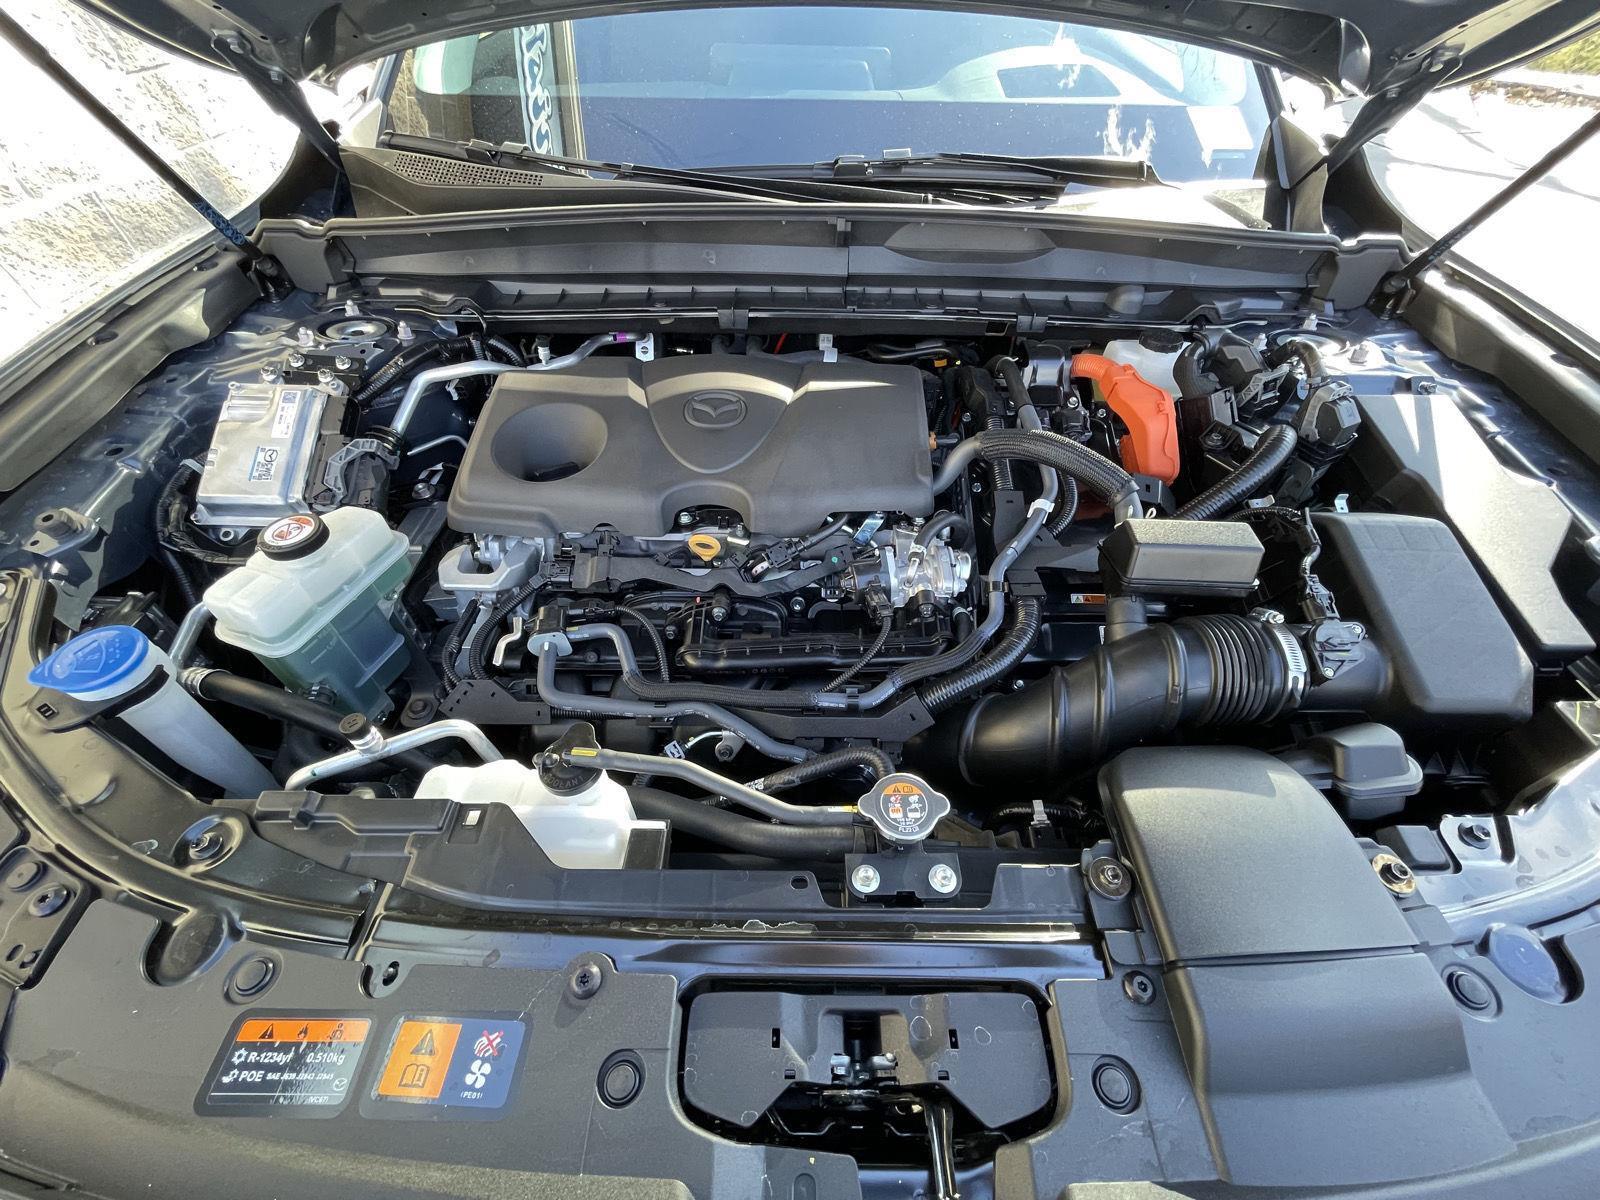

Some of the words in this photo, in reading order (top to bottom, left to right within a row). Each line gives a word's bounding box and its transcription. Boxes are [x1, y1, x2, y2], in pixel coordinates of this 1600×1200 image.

[247, 1051, 293, 1065] R-1234yf
[306, 1052, 346, 1066] 0.510kg
[238, 1070, 265, 1082] POE
[266, 1072, 281, 1080] SAE
